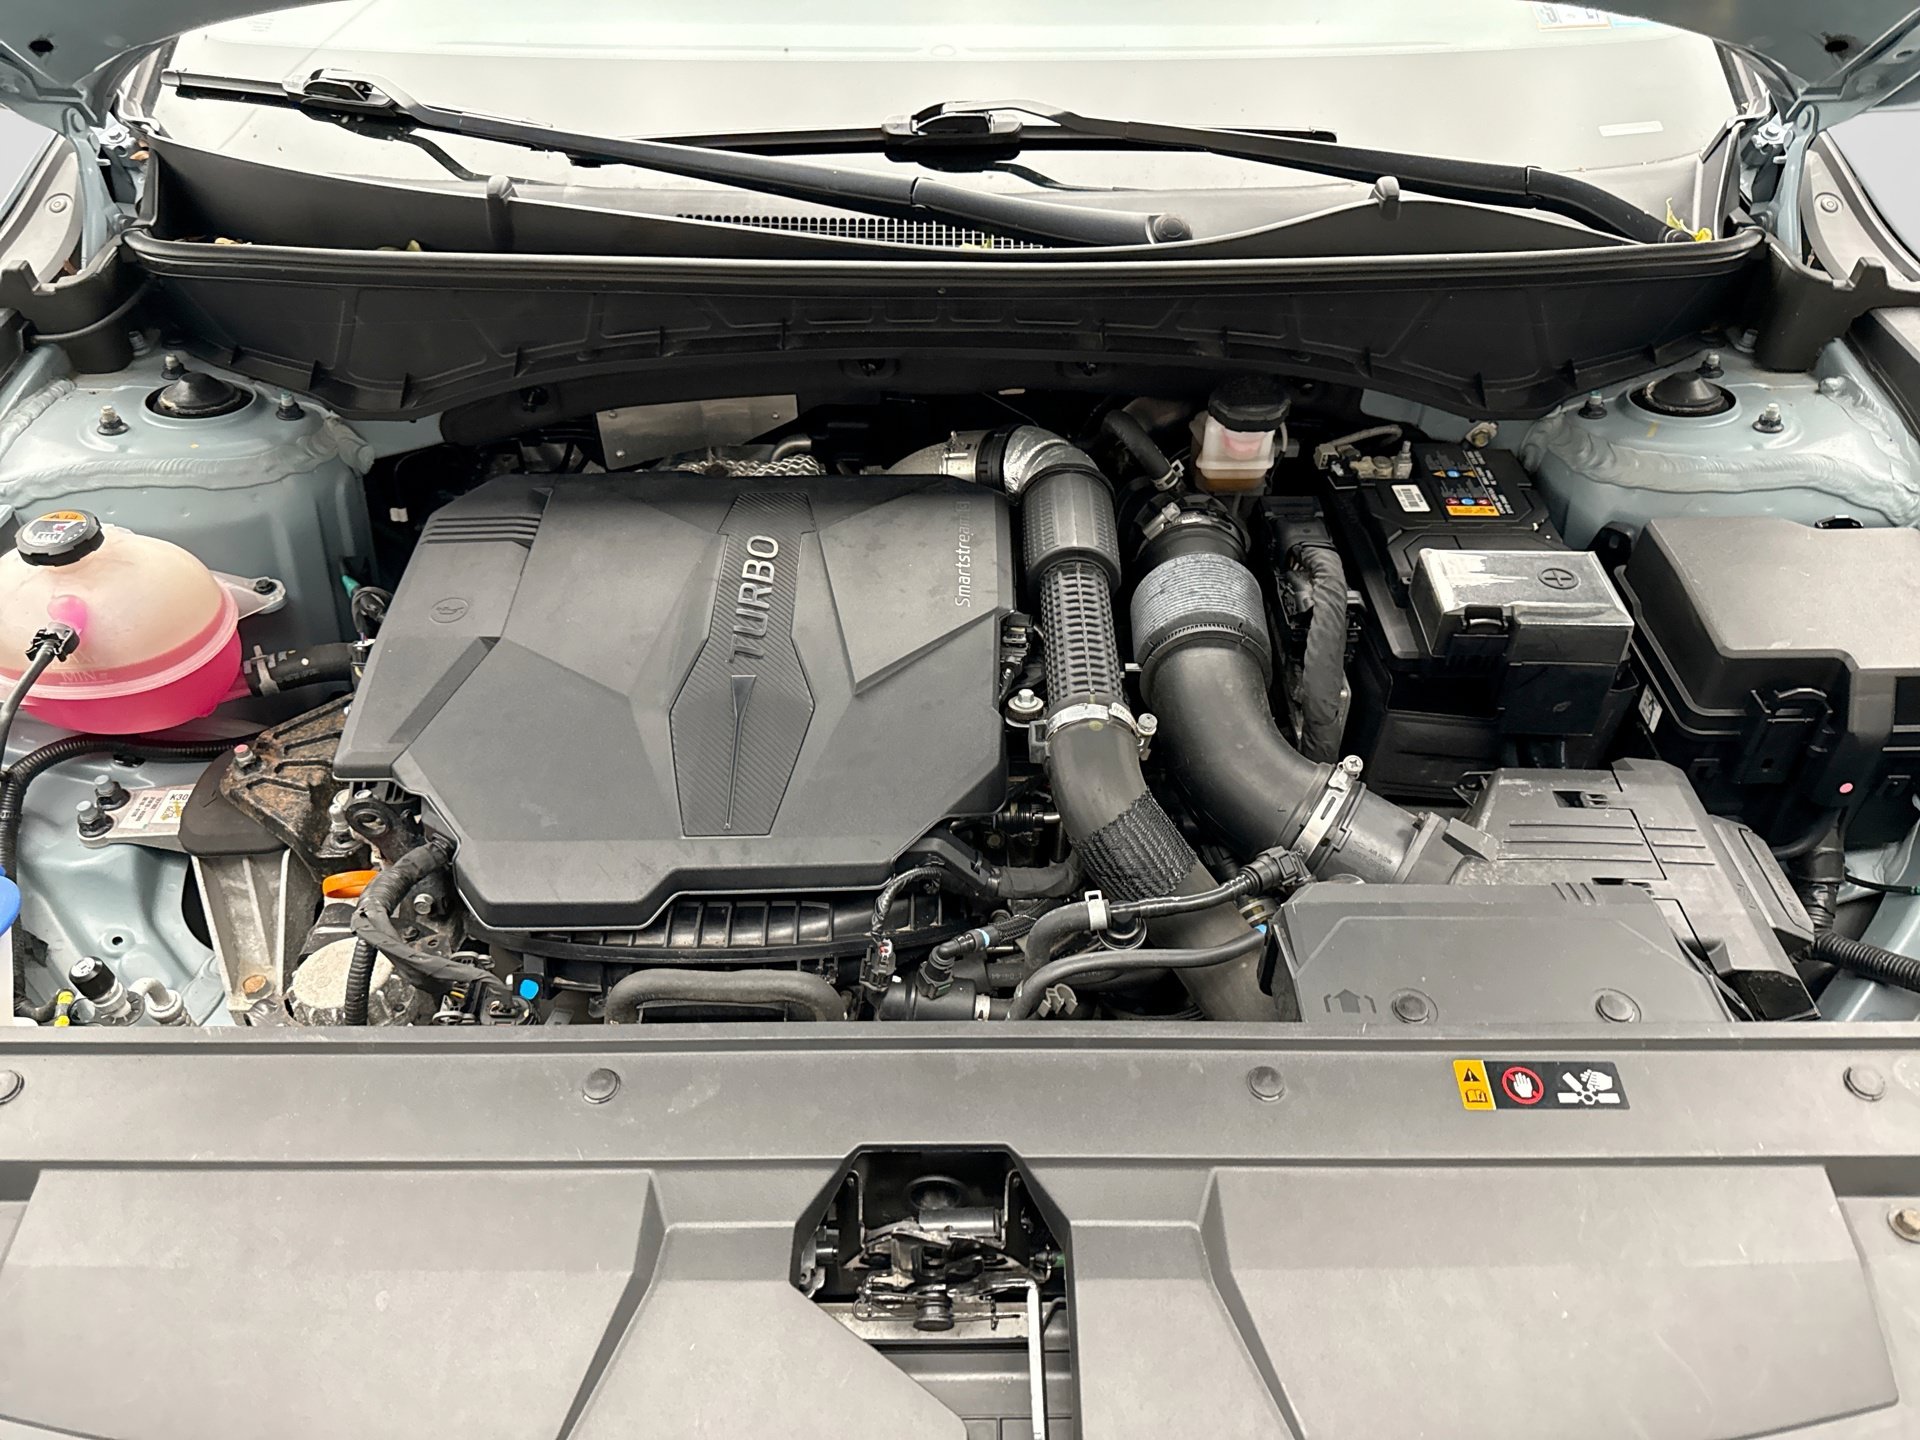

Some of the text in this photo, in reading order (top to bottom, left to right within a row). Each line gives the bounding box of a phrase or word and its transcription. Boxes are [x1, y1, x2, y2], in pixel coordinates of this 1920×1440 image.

[729, 535, 779, 662] TURBO
[954, 515, 971, 608] Smartstream
[62, 671, 97, 682] MIN
